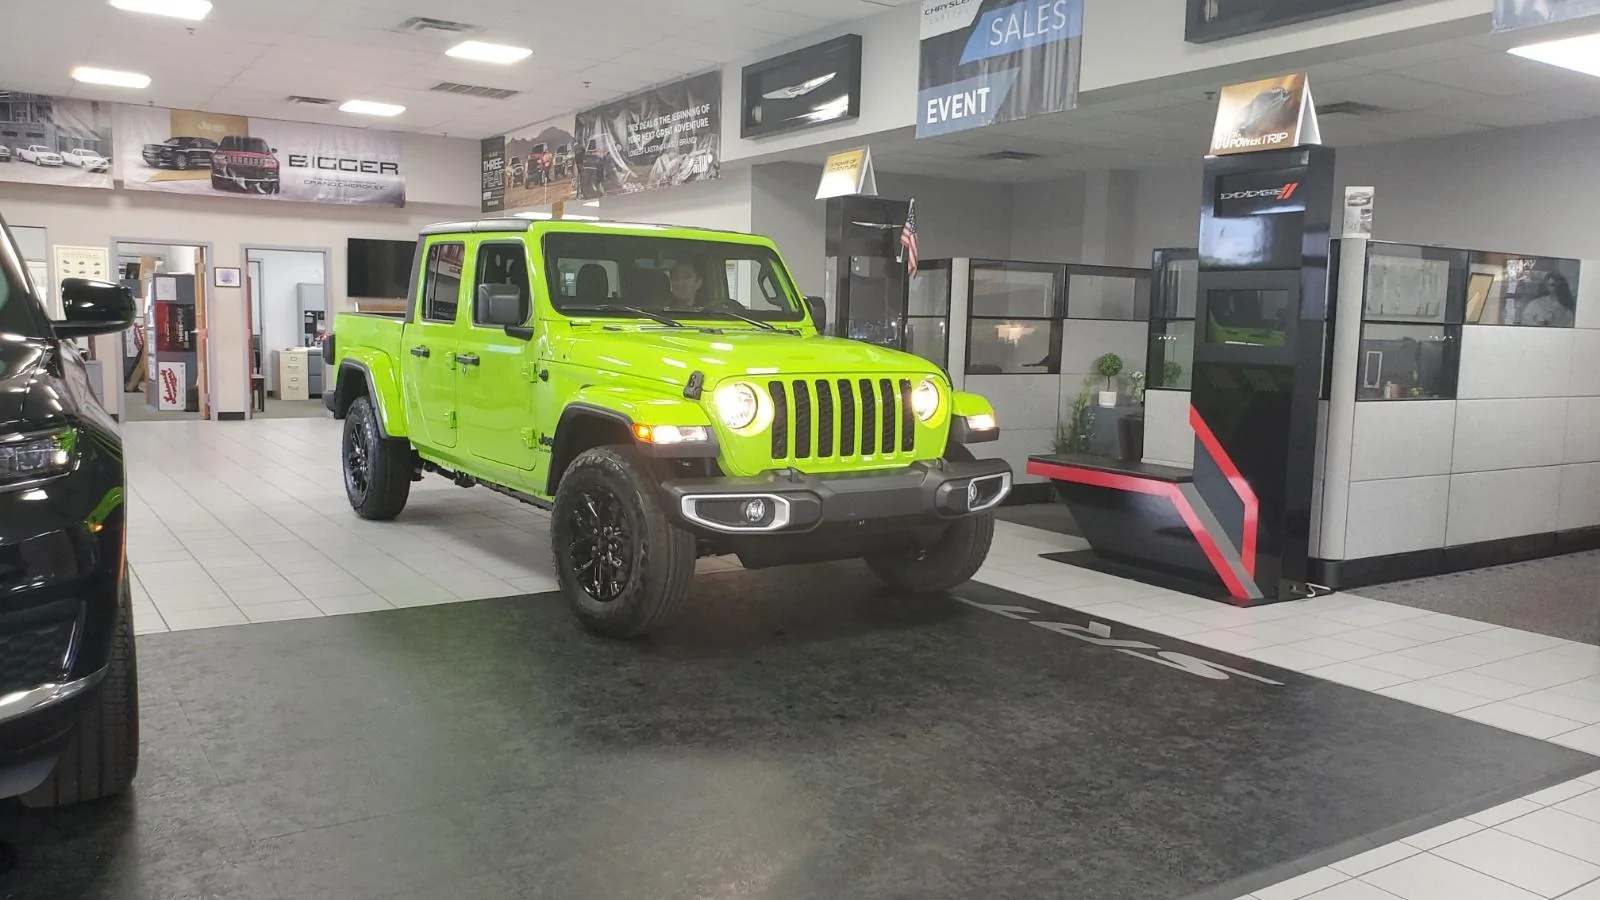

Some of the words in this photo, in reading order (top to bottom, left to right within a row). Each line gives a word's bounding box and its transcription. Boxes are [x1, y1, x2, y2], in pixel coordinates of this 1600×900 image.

[924, 0, 970, 16] CHRYSLE
[990, 0, 1067, 46] SALES
[660, 114, 671, 125] THE
[701, 103, 710, 114] OF
[926, 87, 991, 125] EVENT
[673, 117, 710, 133] ADVENTURE
[288, 154, 399, 176] BIGGER
[1220, 188, 1283, 200] DODGE
[538, 432, 555, 447] Jee
